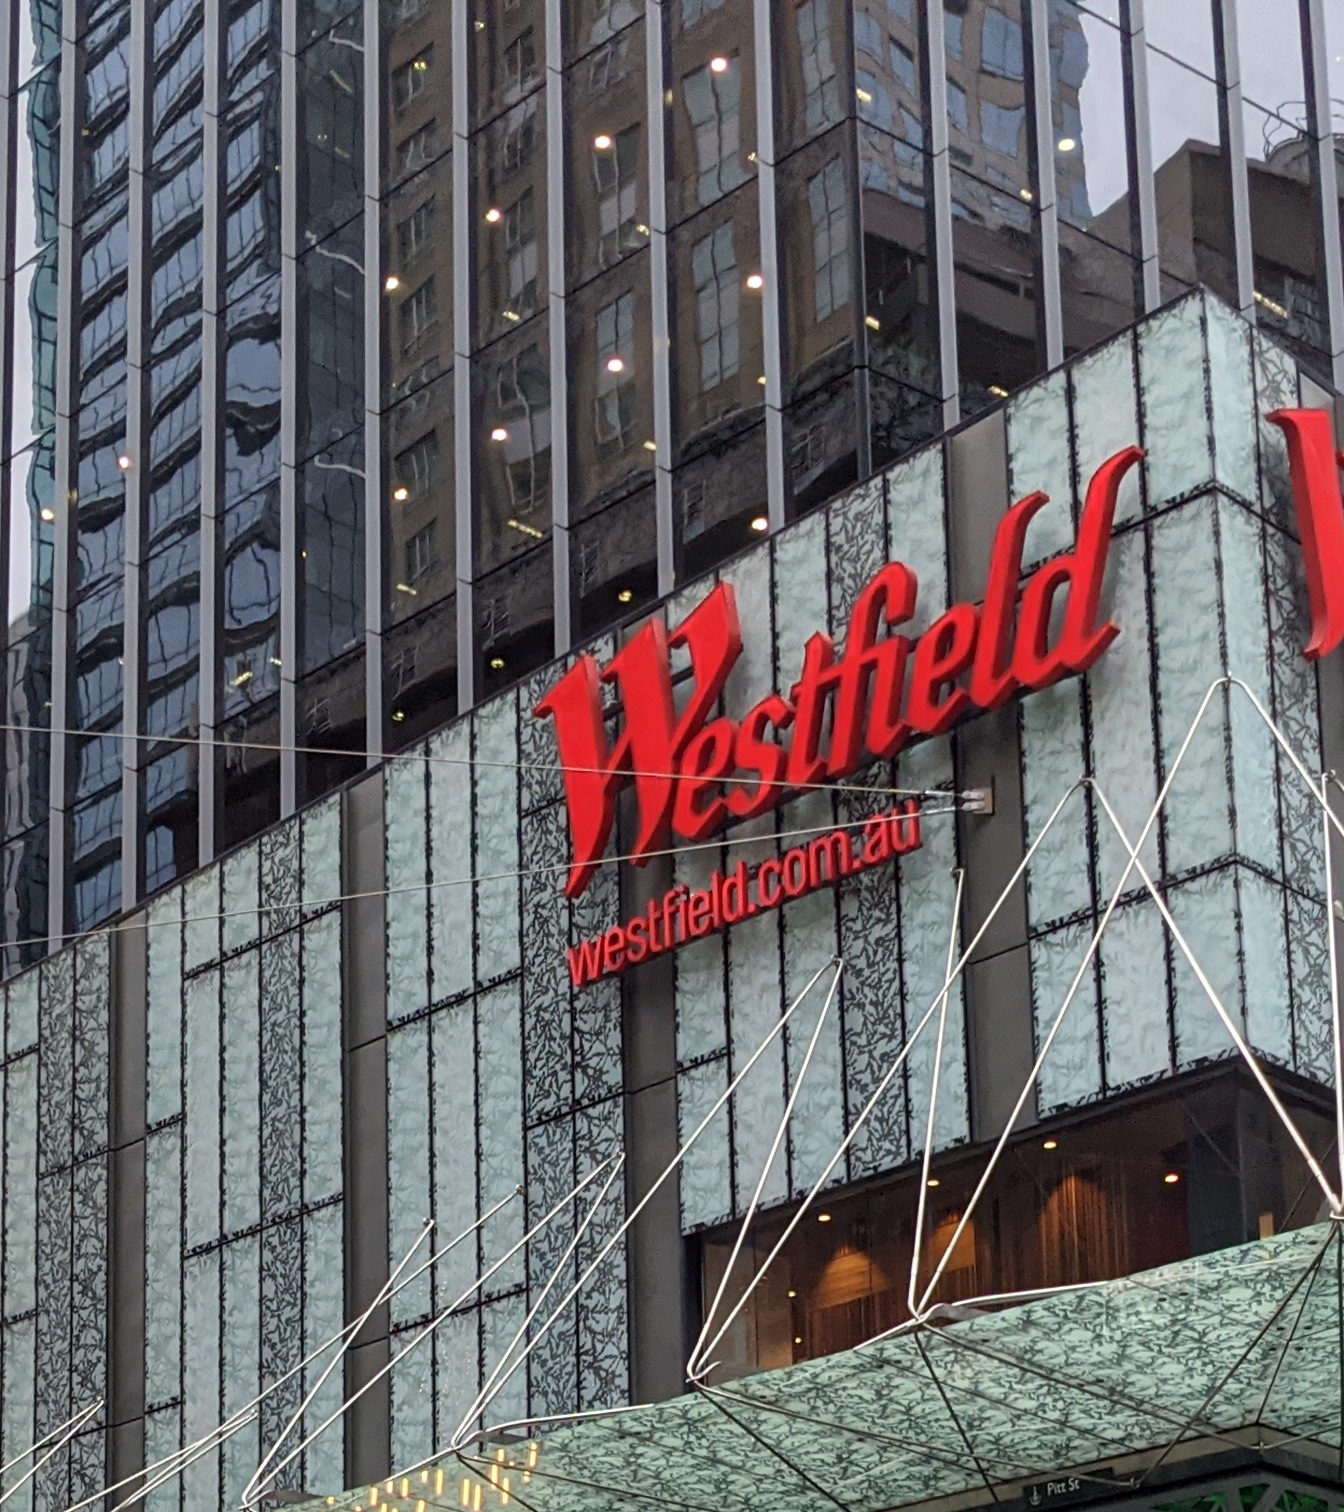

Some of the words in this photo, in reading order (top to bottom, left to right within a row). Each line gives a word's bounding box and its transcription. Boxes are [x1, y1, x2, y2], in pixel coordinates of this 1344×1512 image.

[535, 446, 1145, 898] Westfield
[567, 800, 921, 988] westfield.com.au
[1047, 1482, 1067, 1496] Pitt
[1068, 1477, 1080, 1491] St
